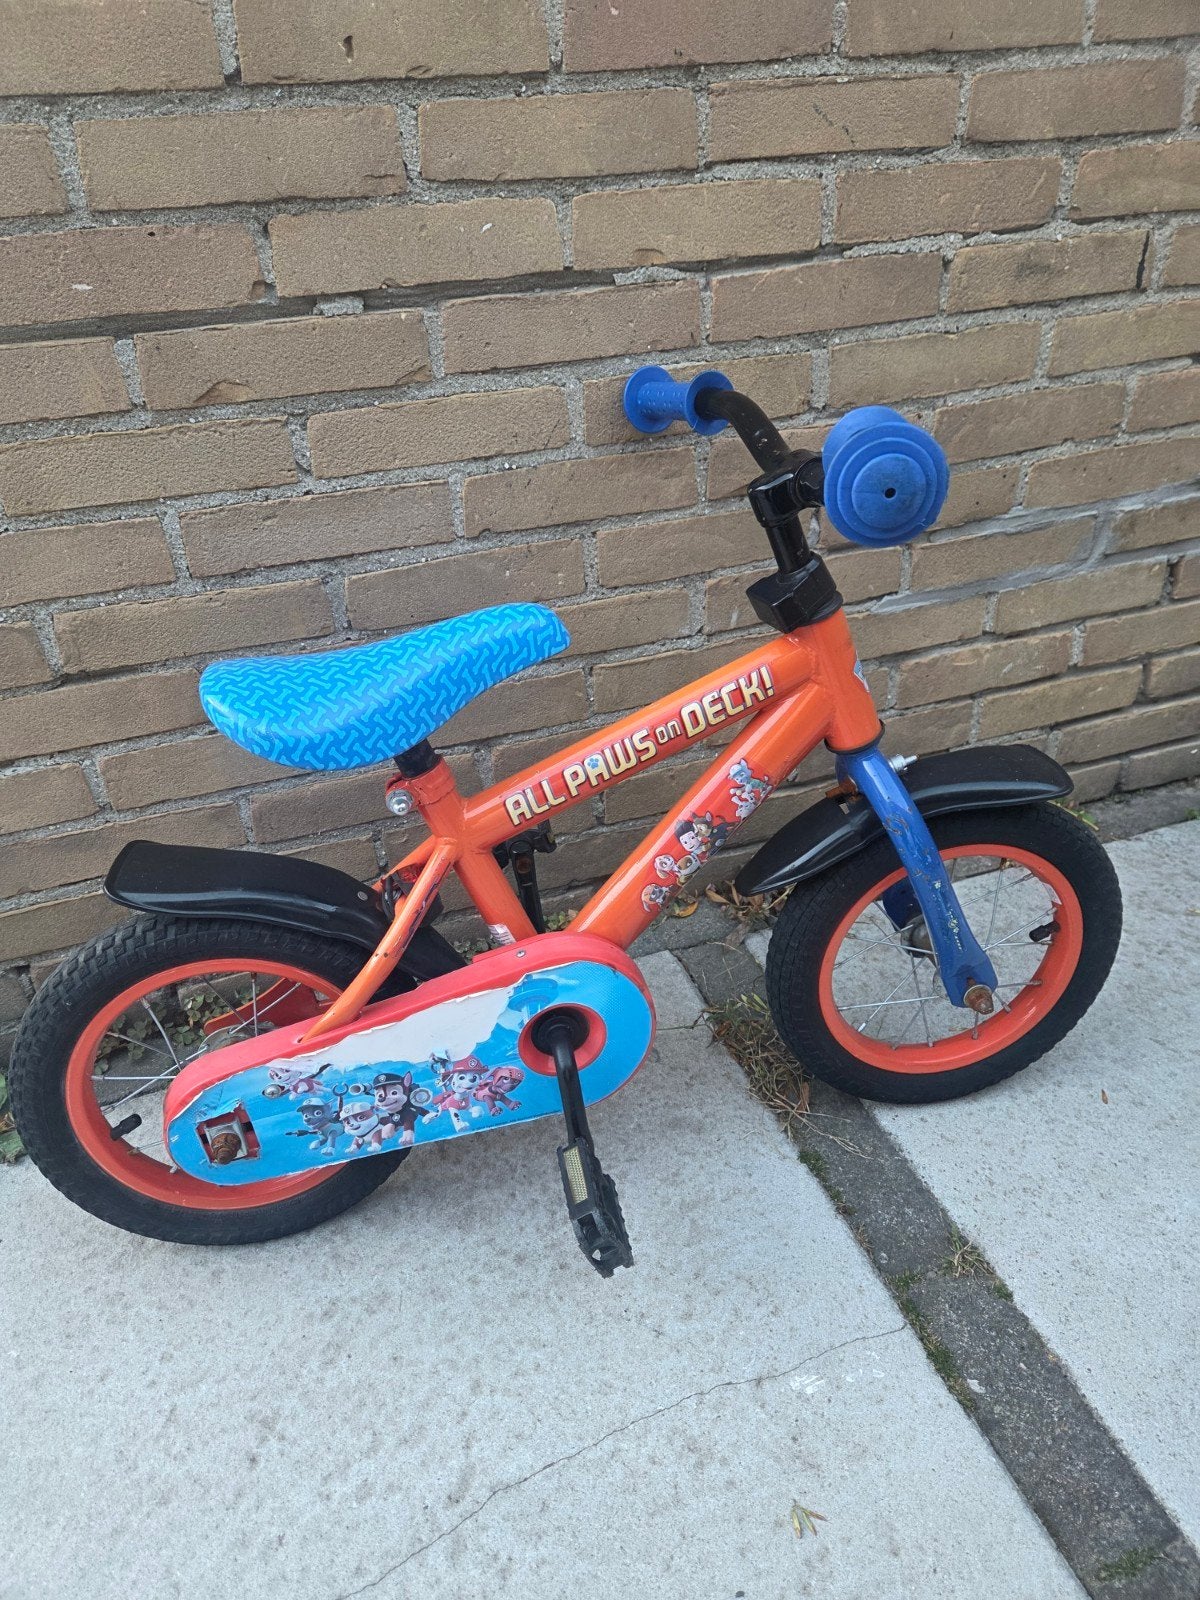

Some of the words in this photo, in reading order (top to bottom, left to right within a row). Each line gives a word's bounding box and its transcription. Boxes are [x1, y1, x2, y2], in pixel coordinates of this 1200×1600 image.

[504, 779, 566, 826] ALL
[563, 729, 658, 797] PAWS
[655, 720, 683, 745] on
[680, 665, 776, 739] DECK!
